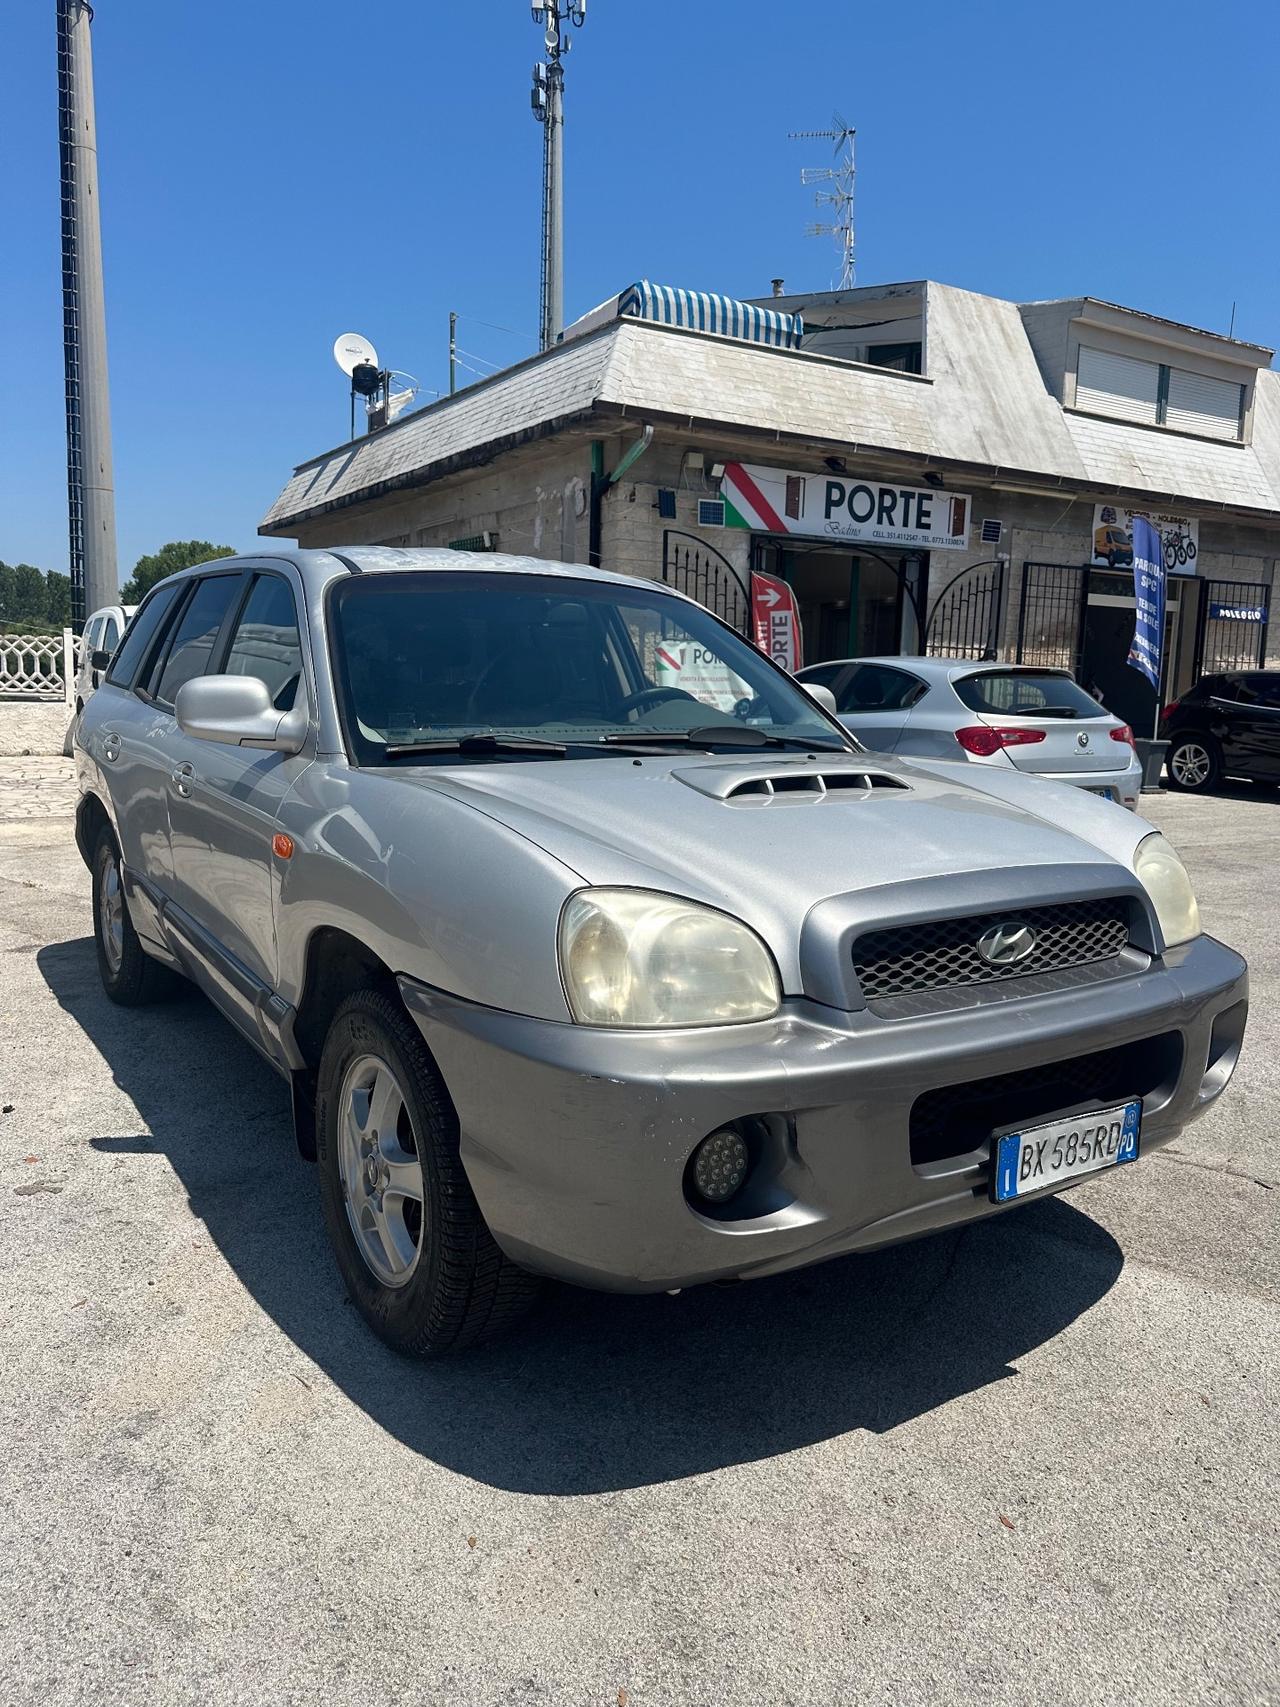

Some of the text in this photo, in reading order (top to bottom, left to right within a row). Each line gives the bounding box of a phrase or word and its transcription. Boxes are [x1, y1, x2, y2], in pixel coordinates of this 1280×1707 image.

[824, 480, 933, 531] PORTE
[1141, 575, 1157, 592] SPC
[1020, 1139, 1048, 1182] BX
[1050, 1121, 1122, 1171] 585RD
[1119, 1132, 1134, 1155] PD
